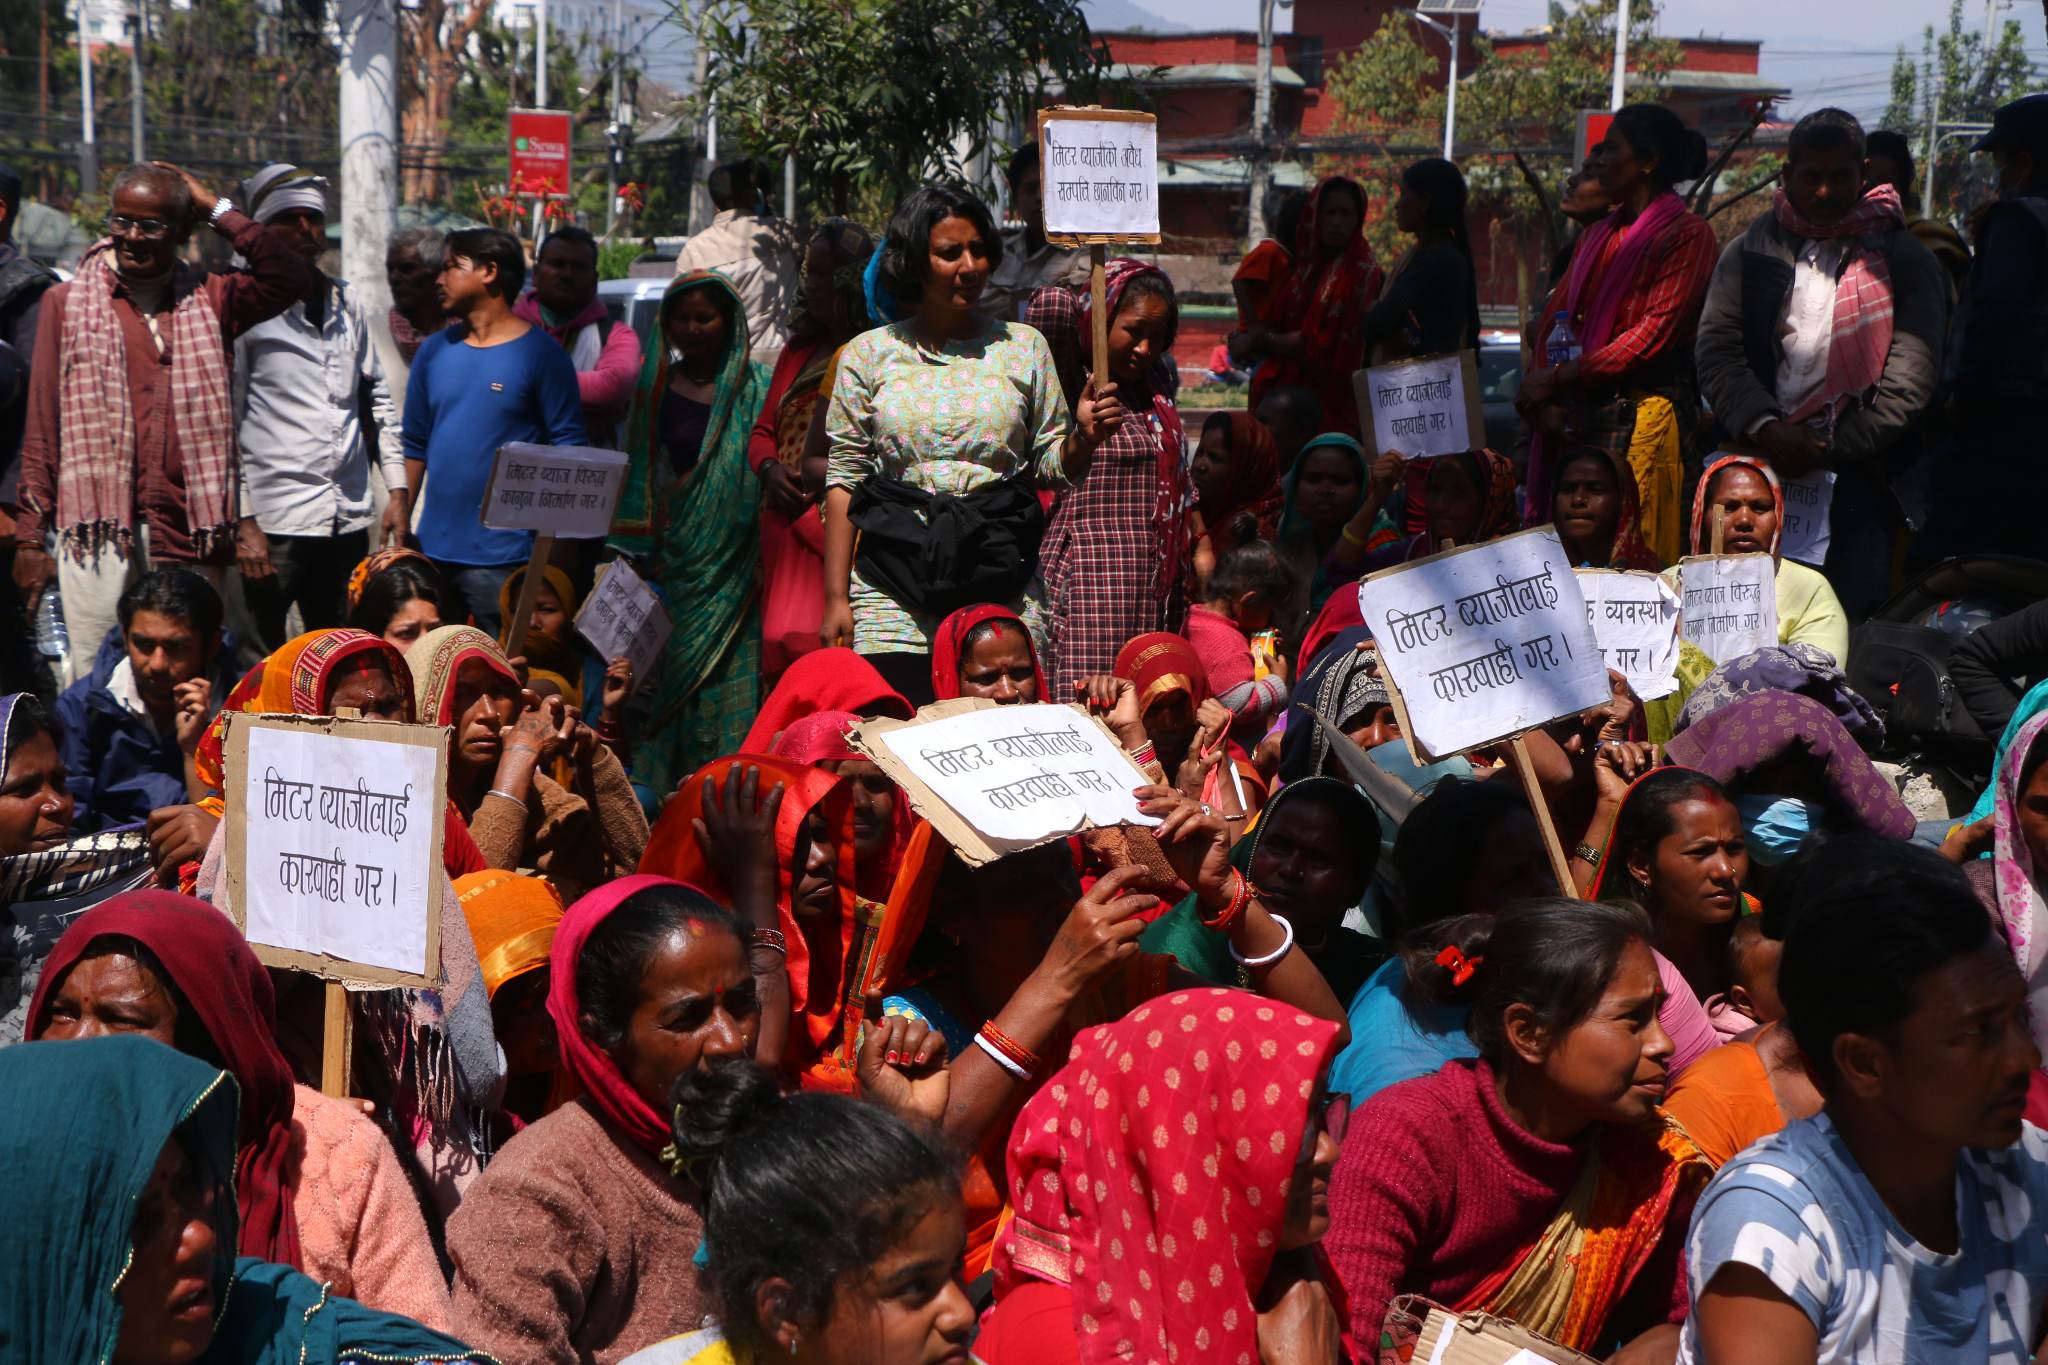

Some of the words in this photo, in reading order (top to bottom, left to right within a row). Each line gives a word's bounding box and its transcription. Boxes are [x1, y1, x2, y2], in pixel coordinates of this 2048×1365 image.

[1052, 140, 1076, 167] मिटर
[1121, 141, 1142, 168] अवैध
[1378, 385, 1402, 408] मिटर
[505, 460, 537, 481] मिटर
[1386, 605, 1453, 653] मिटर
[1455, 560, 1558, 627] ब्याजीलाई
[1604, 600, 1666, 625] व्यवस्था
[920, 743, 993, 777] मिटर
[264, 766, 313, 822] मिटर
[320, 776, 413, 842] ब्याजीलाई
